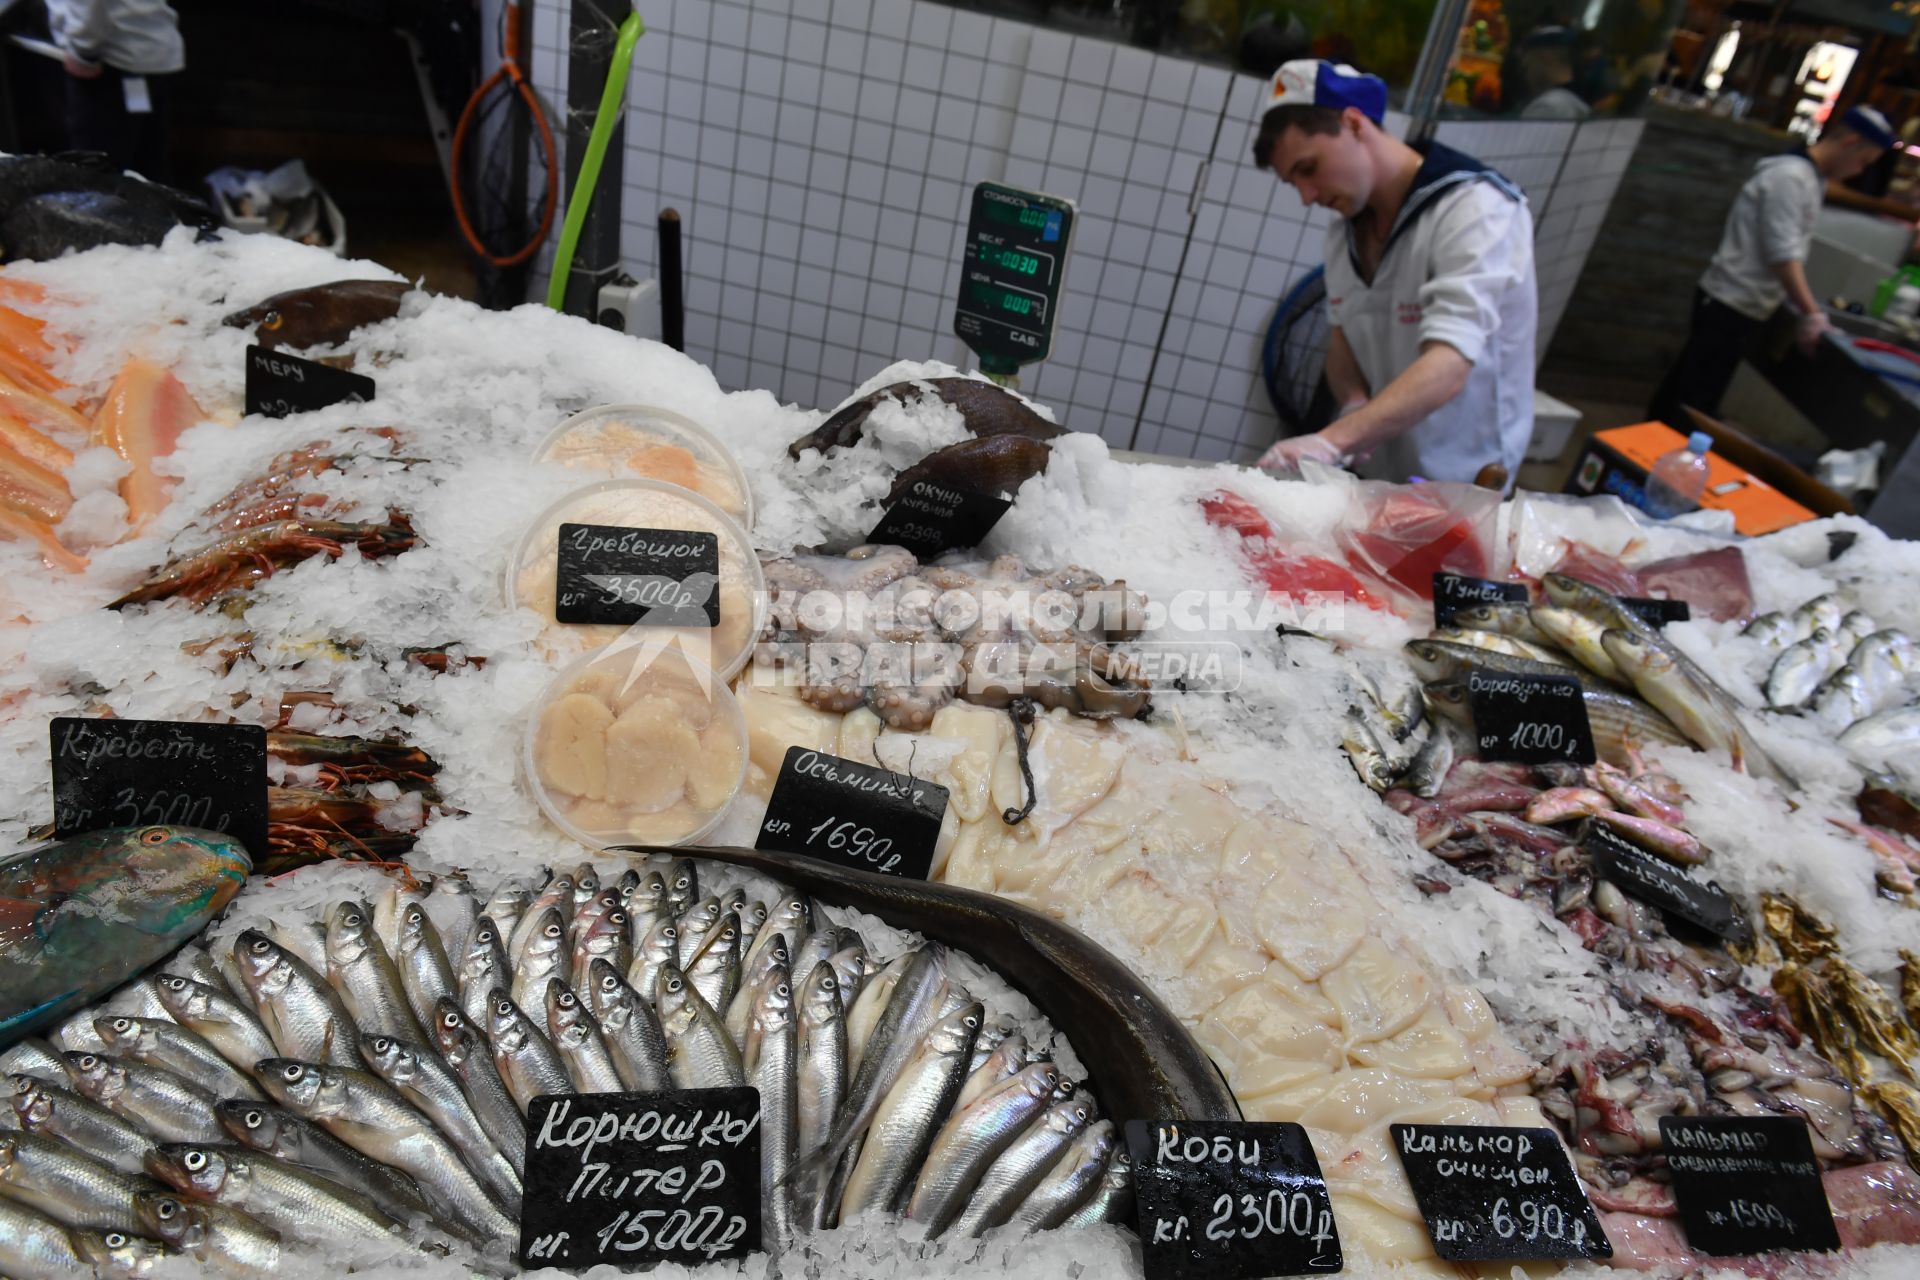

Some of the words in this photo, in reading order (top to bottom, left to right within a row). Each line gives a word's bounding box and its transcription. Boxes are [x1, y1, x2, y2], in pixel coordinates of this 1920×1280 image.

[1010, 332, 1036, 347] CAS
[913, 481, 964, 507] ОКУНЬ
[572, 527, 706, 562] Гребешок
[1443, 575, 1506, 605] Тунец
[534, 1099, 760, 1164] Корюшка
[1156, 1125, 1261, 1167] Коби
[1402, 1127, 1533, 1162] Кальмар
[566, 1159, 726, 1204] Питер
